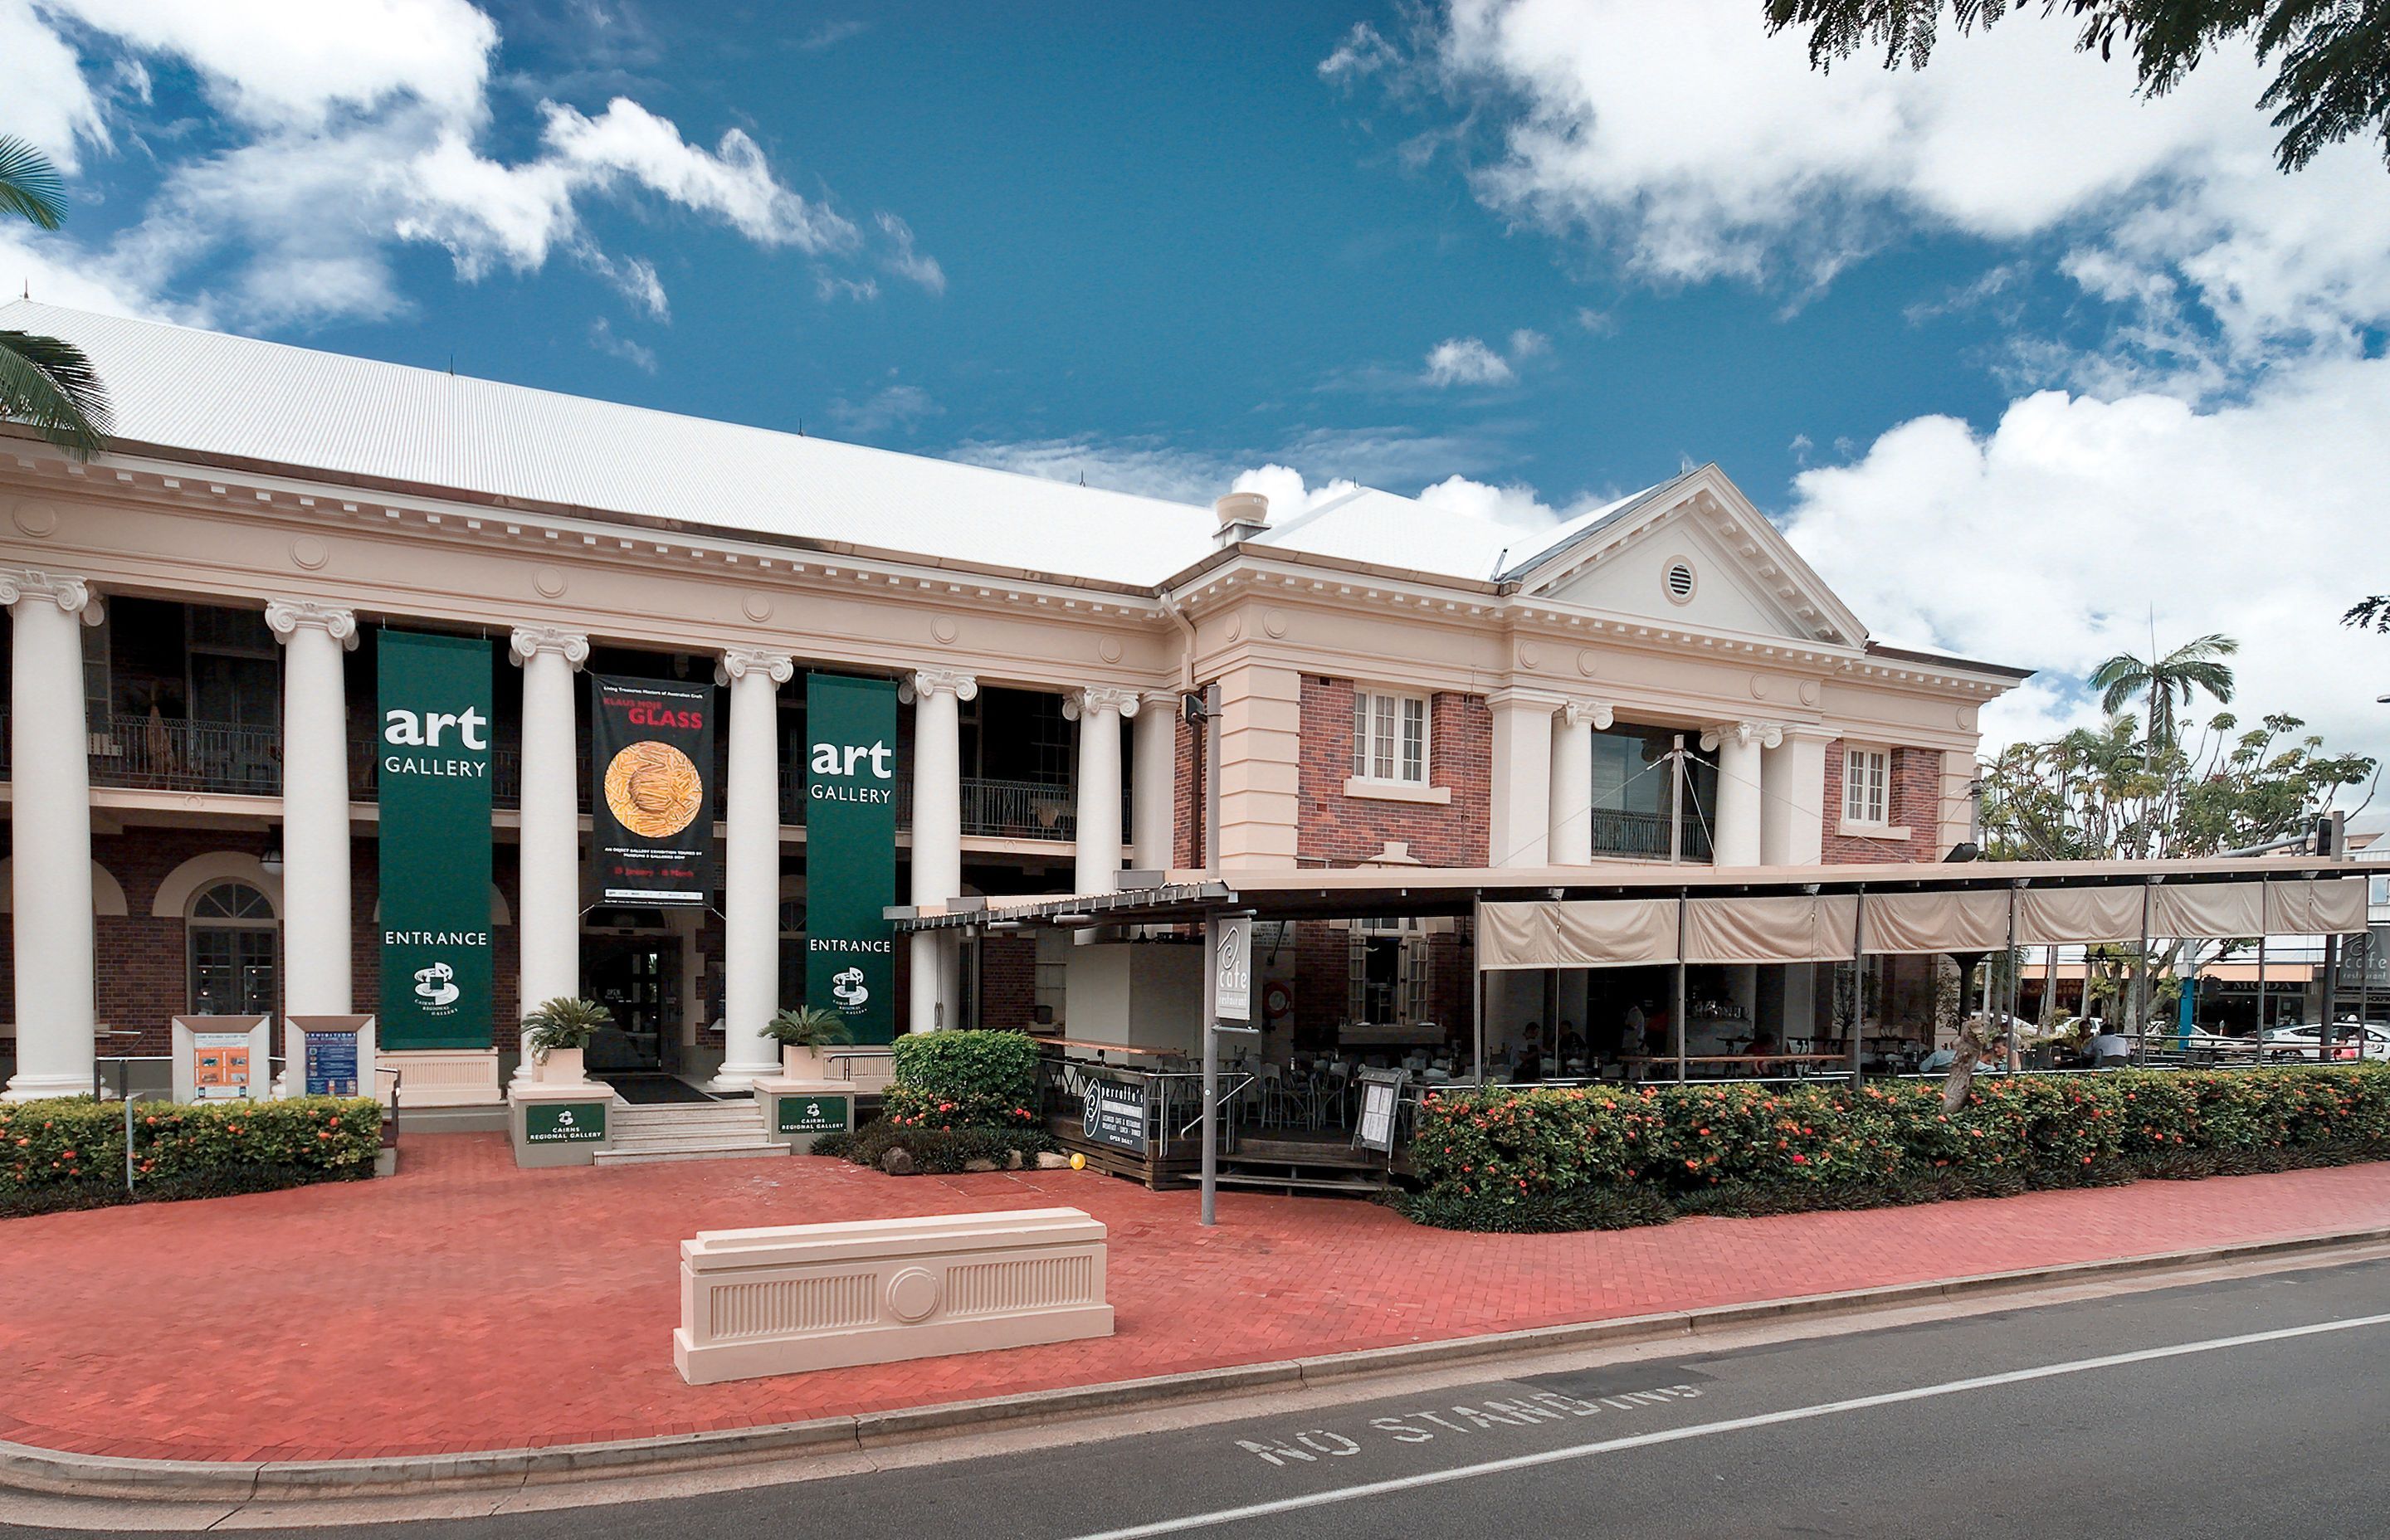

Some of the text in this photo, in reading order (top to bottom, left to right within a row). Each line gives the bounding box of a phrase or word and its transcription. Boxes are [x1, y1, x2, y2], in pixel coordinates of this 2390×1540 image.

[384, 705, 487, 750] art
[628, 707, 702, 729] GLASS
[384, 756, 486, 777] GALLERY
[811, 739, 892, 779] art
[811, 784, 891, 804] GALLERY
[385, 931, 487, 946] ENTRANCE
[810, 938, 890, 953] ENTRANCE
[1219, 960, 1247, 989] cafe
[1234, 1430, 1362, 1466] NO
